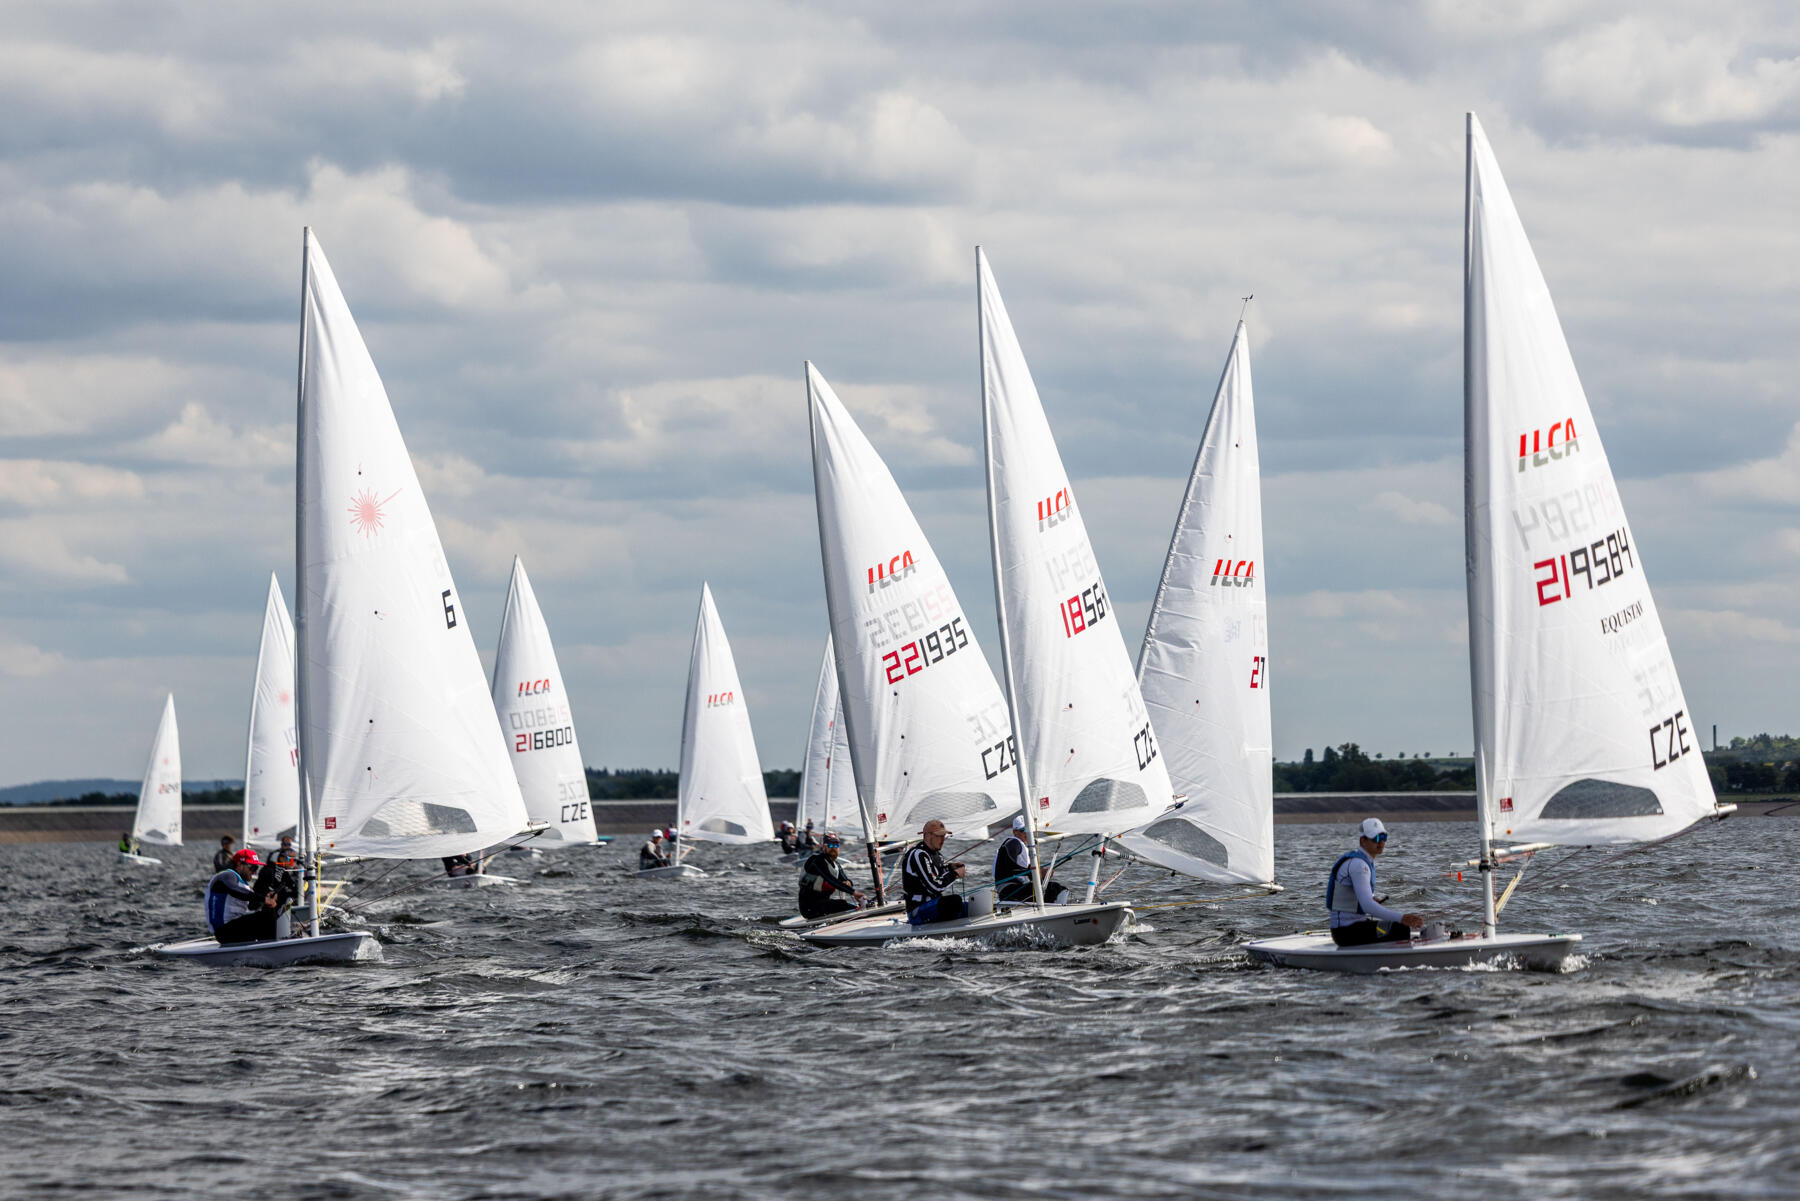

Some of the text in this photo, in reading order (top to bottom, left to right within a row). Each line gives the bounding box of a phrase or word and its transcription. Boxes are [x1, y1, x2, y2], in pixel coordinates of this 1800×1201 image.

[1518, 417, 1581, 473] ILCA
[1037, 487, 1073, 533] ILCA
[868, 550, 920, 594] ILCA
[1210, 559, 1255, 588] ILCA
[1533, 527, 1634, 607] 219584
[441, 589, 457, 629] 6
[882, 617, 969, 685] 221935
[518, 679, 551, 697] ILCA
[707, 691, 734, 708] ILCA
[516, 726, 572, 752] 216800
[1134, 721, 1157, 771] CZE
[1650, 710, 1691, 771] CZE
[561, 802, 588, 823] CZE
